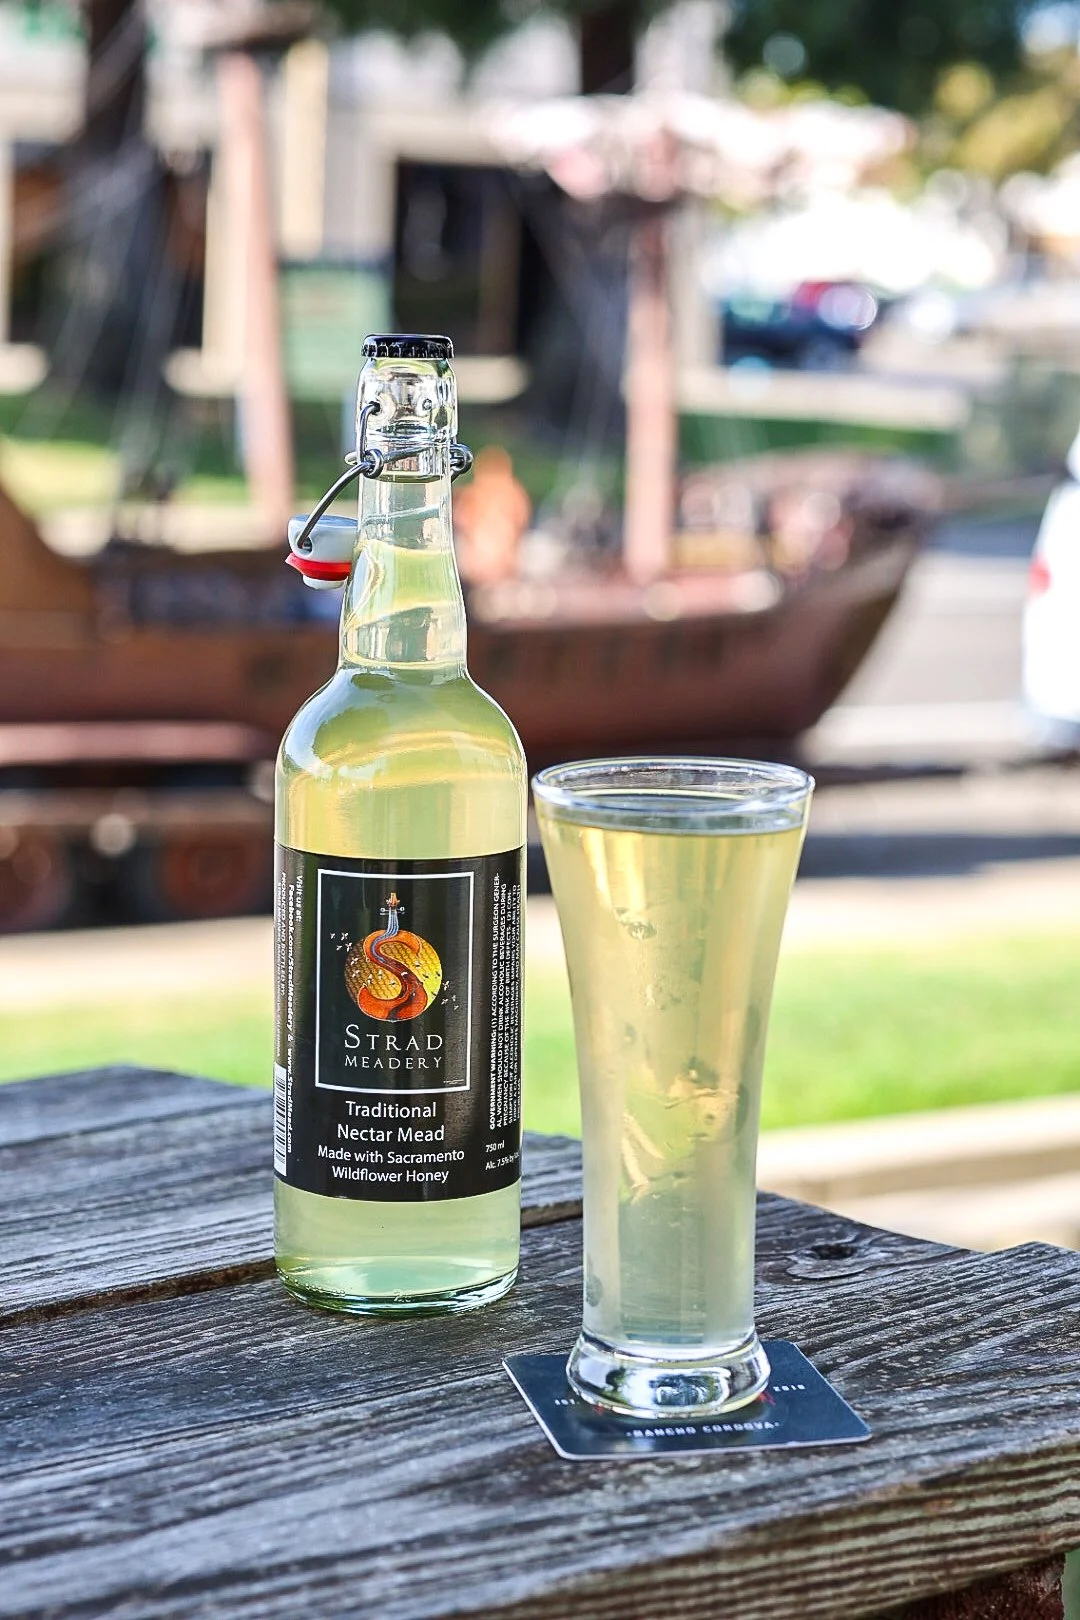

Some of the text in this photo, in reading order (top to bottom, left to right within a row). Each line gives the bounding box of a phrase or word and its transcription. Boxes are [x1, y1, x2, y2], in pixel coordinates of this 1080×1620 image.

[286, 884, 294, 1032] Facebook.com/StradMeadery
[492, 958, 498, 970] TO
[344, 1054, 442, 1070] MEADERY
[345, 1100, 437, 1118] Traditional
[337, 1124, 445, 1142] Nectar Mead
[318, 1144, 465, 1164] Made with Sacramento
[485, 1140, 504, 1152] 750 ml
[332, 1166, 450, 1184] Wildflower Honey
